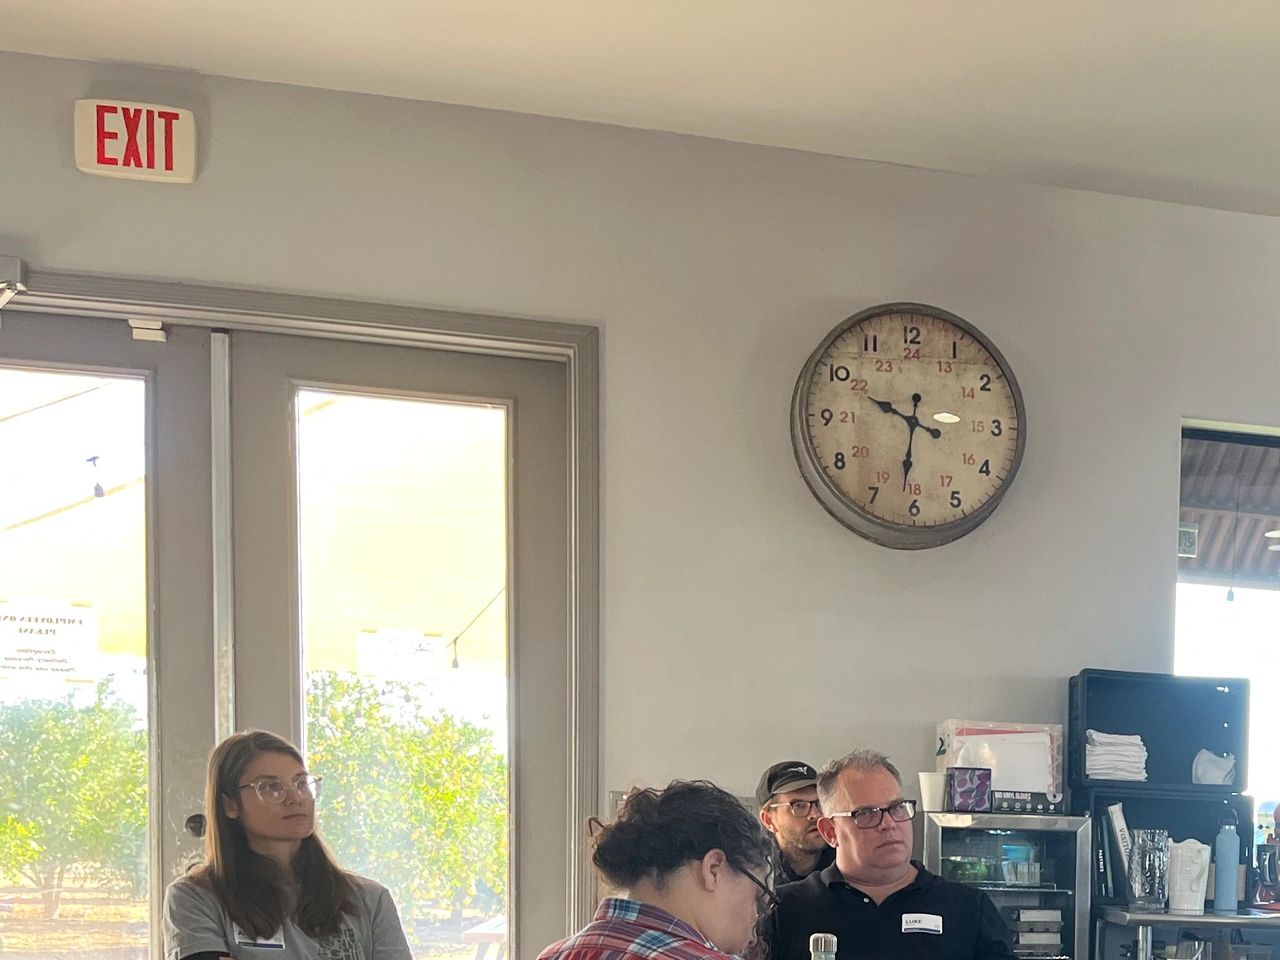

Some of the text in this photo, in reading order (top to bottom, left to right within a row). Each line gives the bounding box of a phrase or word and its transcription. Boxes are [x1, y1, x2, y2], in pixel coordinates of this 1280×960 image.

[96, 104, 180, 171] EXIT
[864, 334, 877, 352] 11
[903, 325, 921, 345] 12
[903, 349, 920, 360] 24
[952, 341, 957, 359] 1
[829, 364, 850, 382] 10
[875, 361, 893, 373] 23
[938, 361, 952, 373] 13
[850, 379, 868, 391] 22
[979, 374, 991, 392] 2
[961, 386, 975, 399] 14
[820, 408, 833, 426] 9
[840, 411, 855, 423] 21
[971, 420, 984, 432] 15
[991, 420, 1002, 437] 3
[851, 446, 869, 458] 20
[962, 453, 975, 465] 16
[834, 452, 846, 470] 8
[978, 459, 991, 476] 4
[876, 471, 889, 484] 19
[940, 475, 953, 488] 17
[868, 486, 879, 504] 7
[908, 483, 921, 495] 18
[908, 499, 920, 516] 6
[949, 491, 961, 508] 5
[1119, 827, 1130, 857] VISITO
